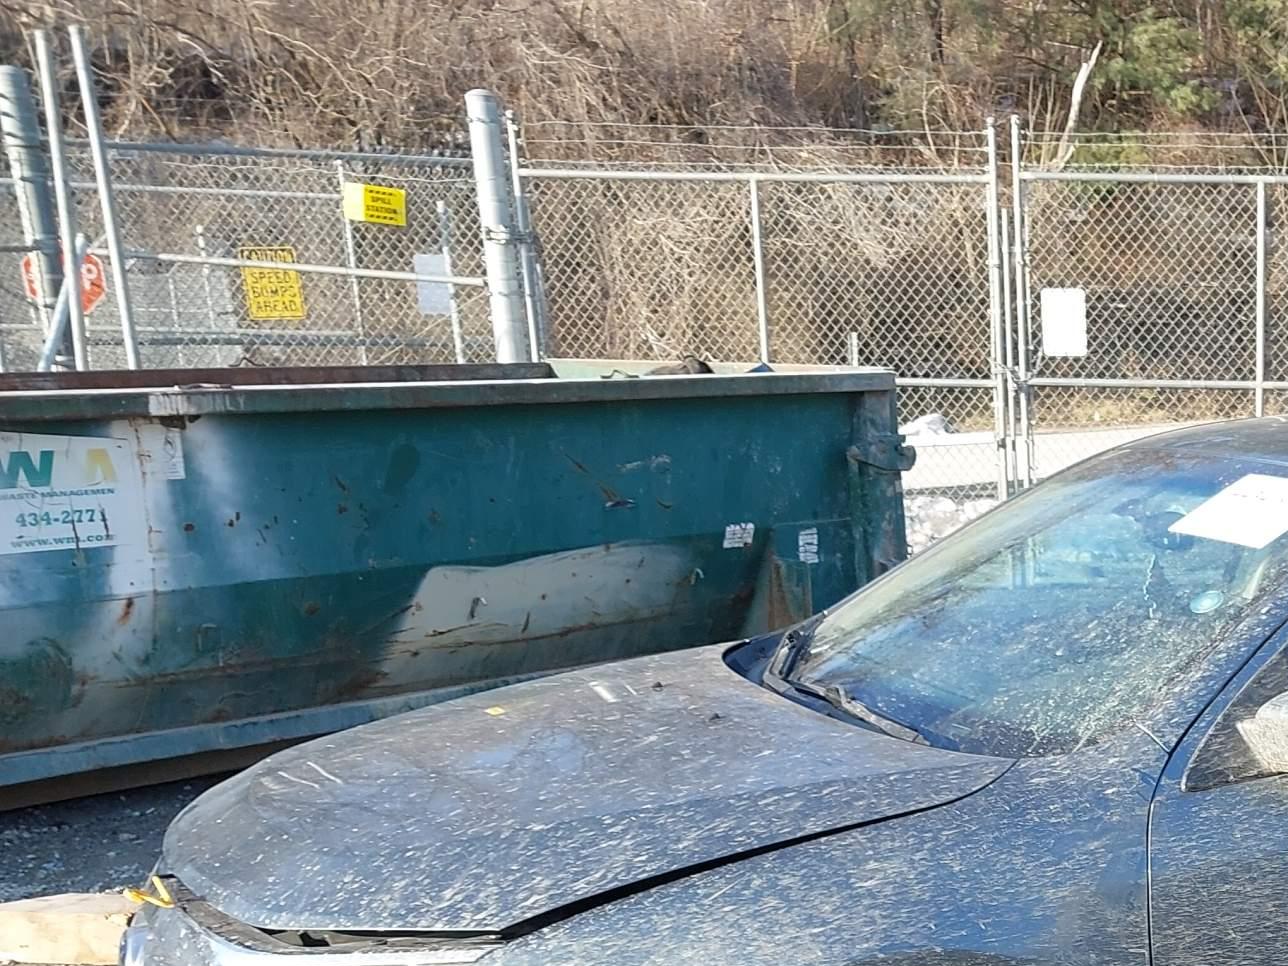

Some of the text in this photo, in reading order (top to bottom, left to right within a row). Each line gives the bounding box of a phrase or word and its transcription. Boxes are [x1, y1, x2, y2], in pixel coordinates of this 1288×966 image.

[365, 204, 398, 215] STATION
[250, 271, 292, 284] SPEED
[251, 285, 297, 299] BUMPS
[255, 299, 297, 313] AHEAD
